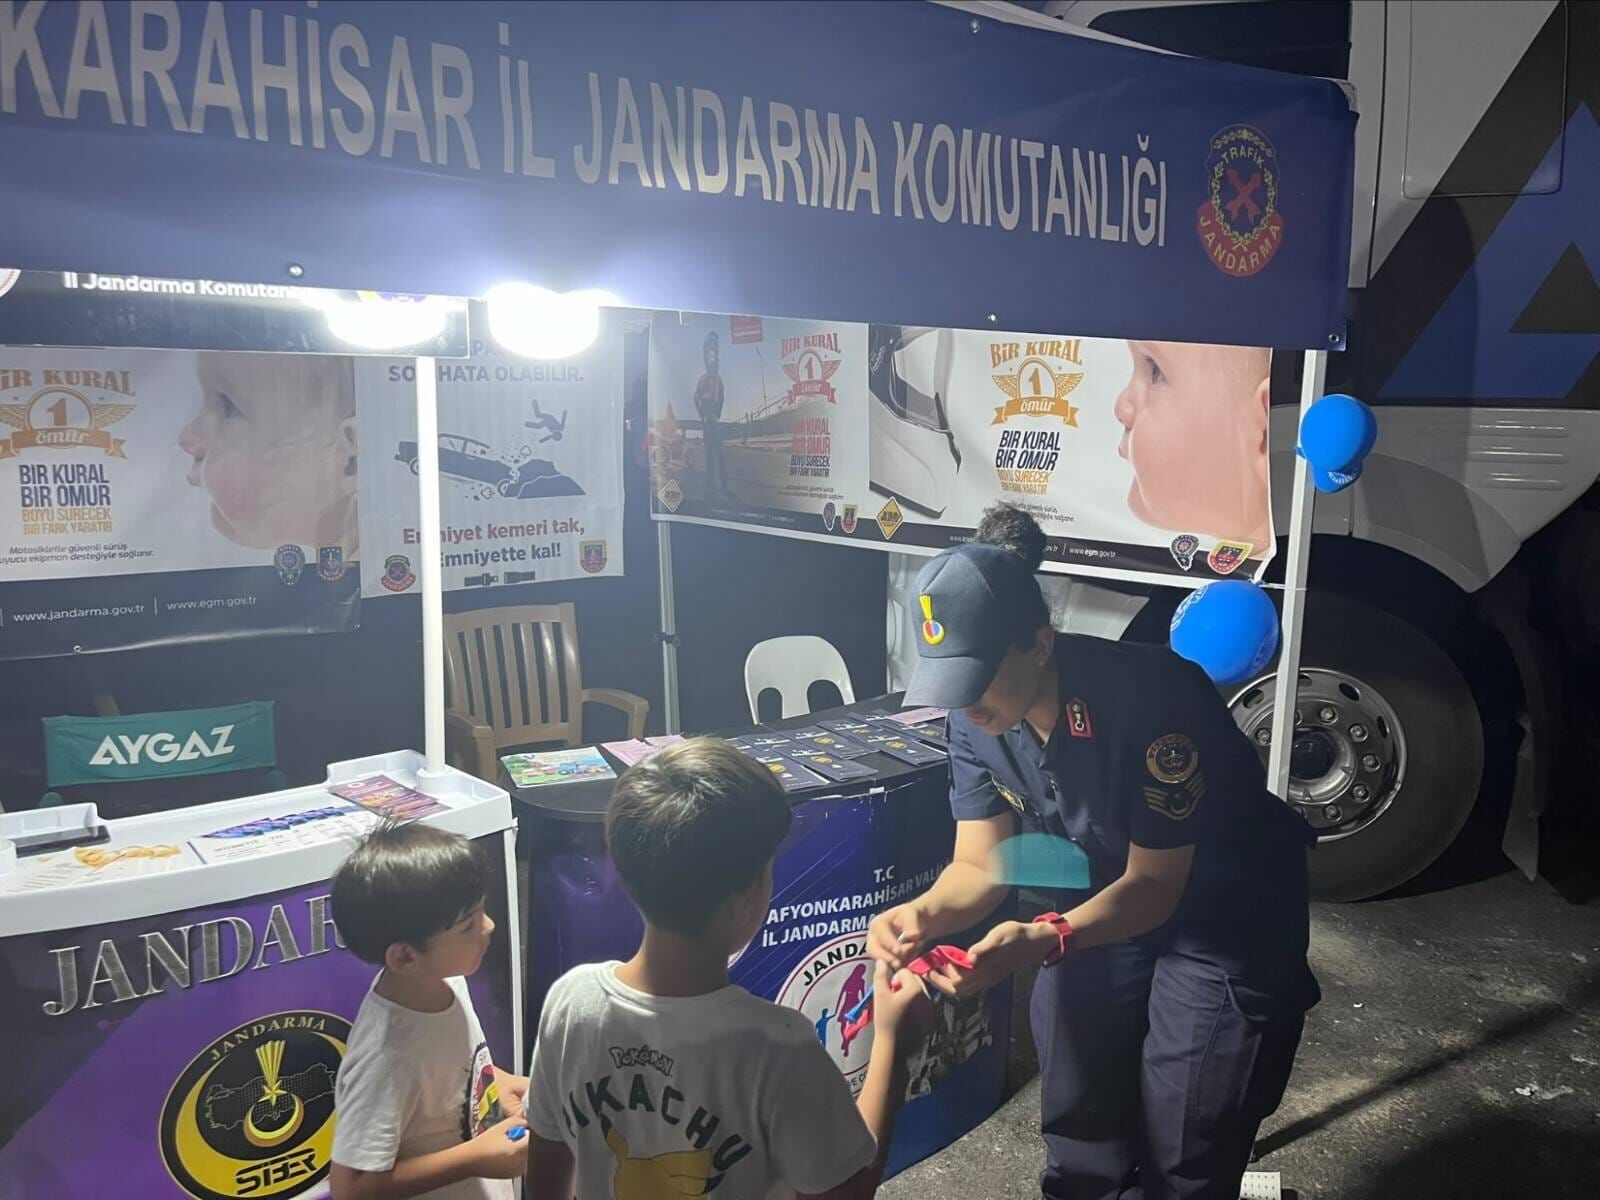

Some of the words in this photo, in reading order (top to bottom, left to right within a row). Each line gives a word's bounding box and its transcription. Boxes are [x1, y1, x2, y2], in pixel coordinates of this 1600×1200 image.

[499, 23, 555, 179] İL
[574, 71, 879, 214] JANDARMA
[891, 120, 1167, 248] KOMUTANLIĞI
[1221, 144, 1265, 169] TRAFİK
[1199, 215, 1281, 273] JANDARMA
[82, 273, 195, 295] Jandarma
[1025, 339, 1083, 366] KURAL
[388, 365, 417, 383] SO
[438, 364, 490, 383] HATA
[805, 356, 814, 380] 1
[43, 368, 137, 397] KURAL
[1028, 367, 1042, 396] 1
[46, 397, 68, 427] 1
[1020, 399, 1056, 413] ömür
[1021, 430, 1061, 451] KURAL
[53, 463, 110, 484] KURAL
[487, 519, 548, 539] kemeri
[552, 517, 585, 536] tak,
[531, 542, 561, 560] kal!
[13, 604, 145, 622] www.jandarma.gov.tr
[167, 596, 257, 611] www.egm.gov.tr
[88, 724, 235, 765] AYGAZ
[766, 878, 913, 925] AFYONKARAHİSAR
[762, 929, 778, 948] İL
[210, 1016, 327, 1061] JANDARMA
